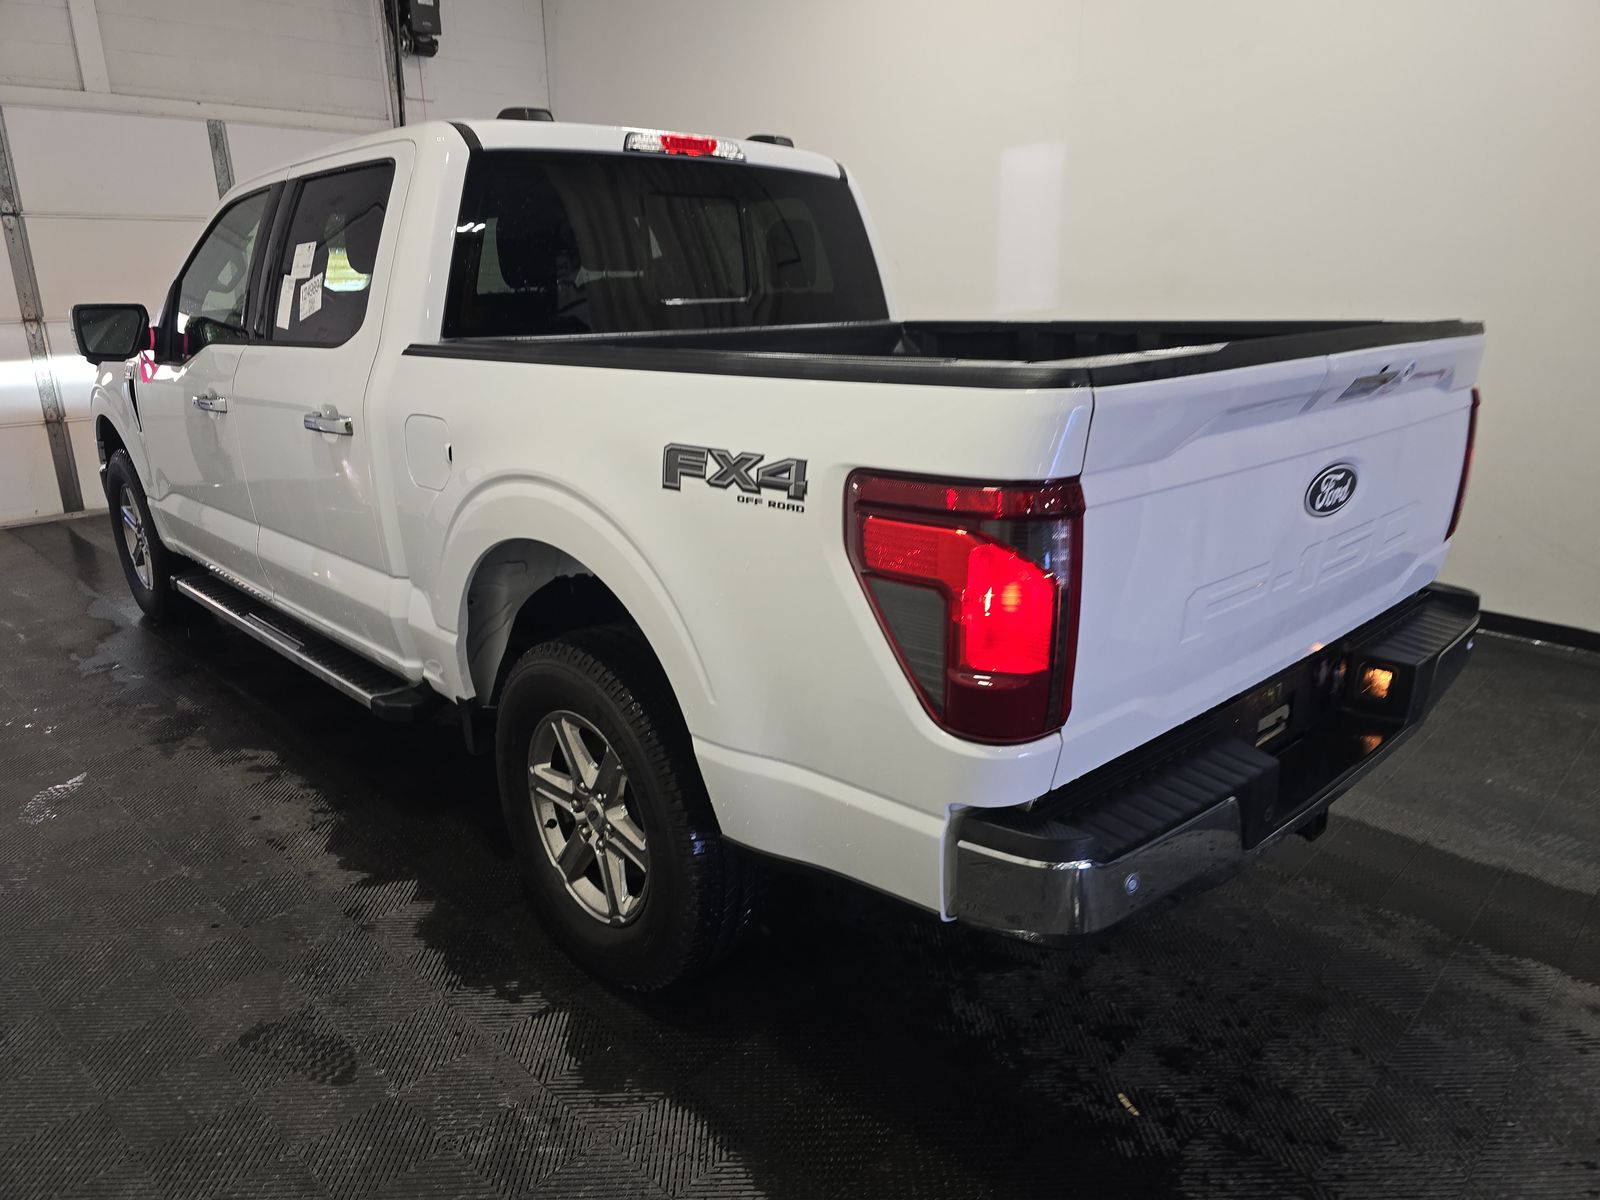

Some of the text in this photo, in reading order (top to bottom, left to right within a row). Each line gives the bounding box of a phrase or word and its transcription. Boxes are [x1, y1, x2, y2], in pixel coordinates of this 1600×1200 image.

[662, 443, 807, 501] FX4
[1315, 471, 1353, 510] Ford
[737, 495, 805, 513] OFF ROAD
